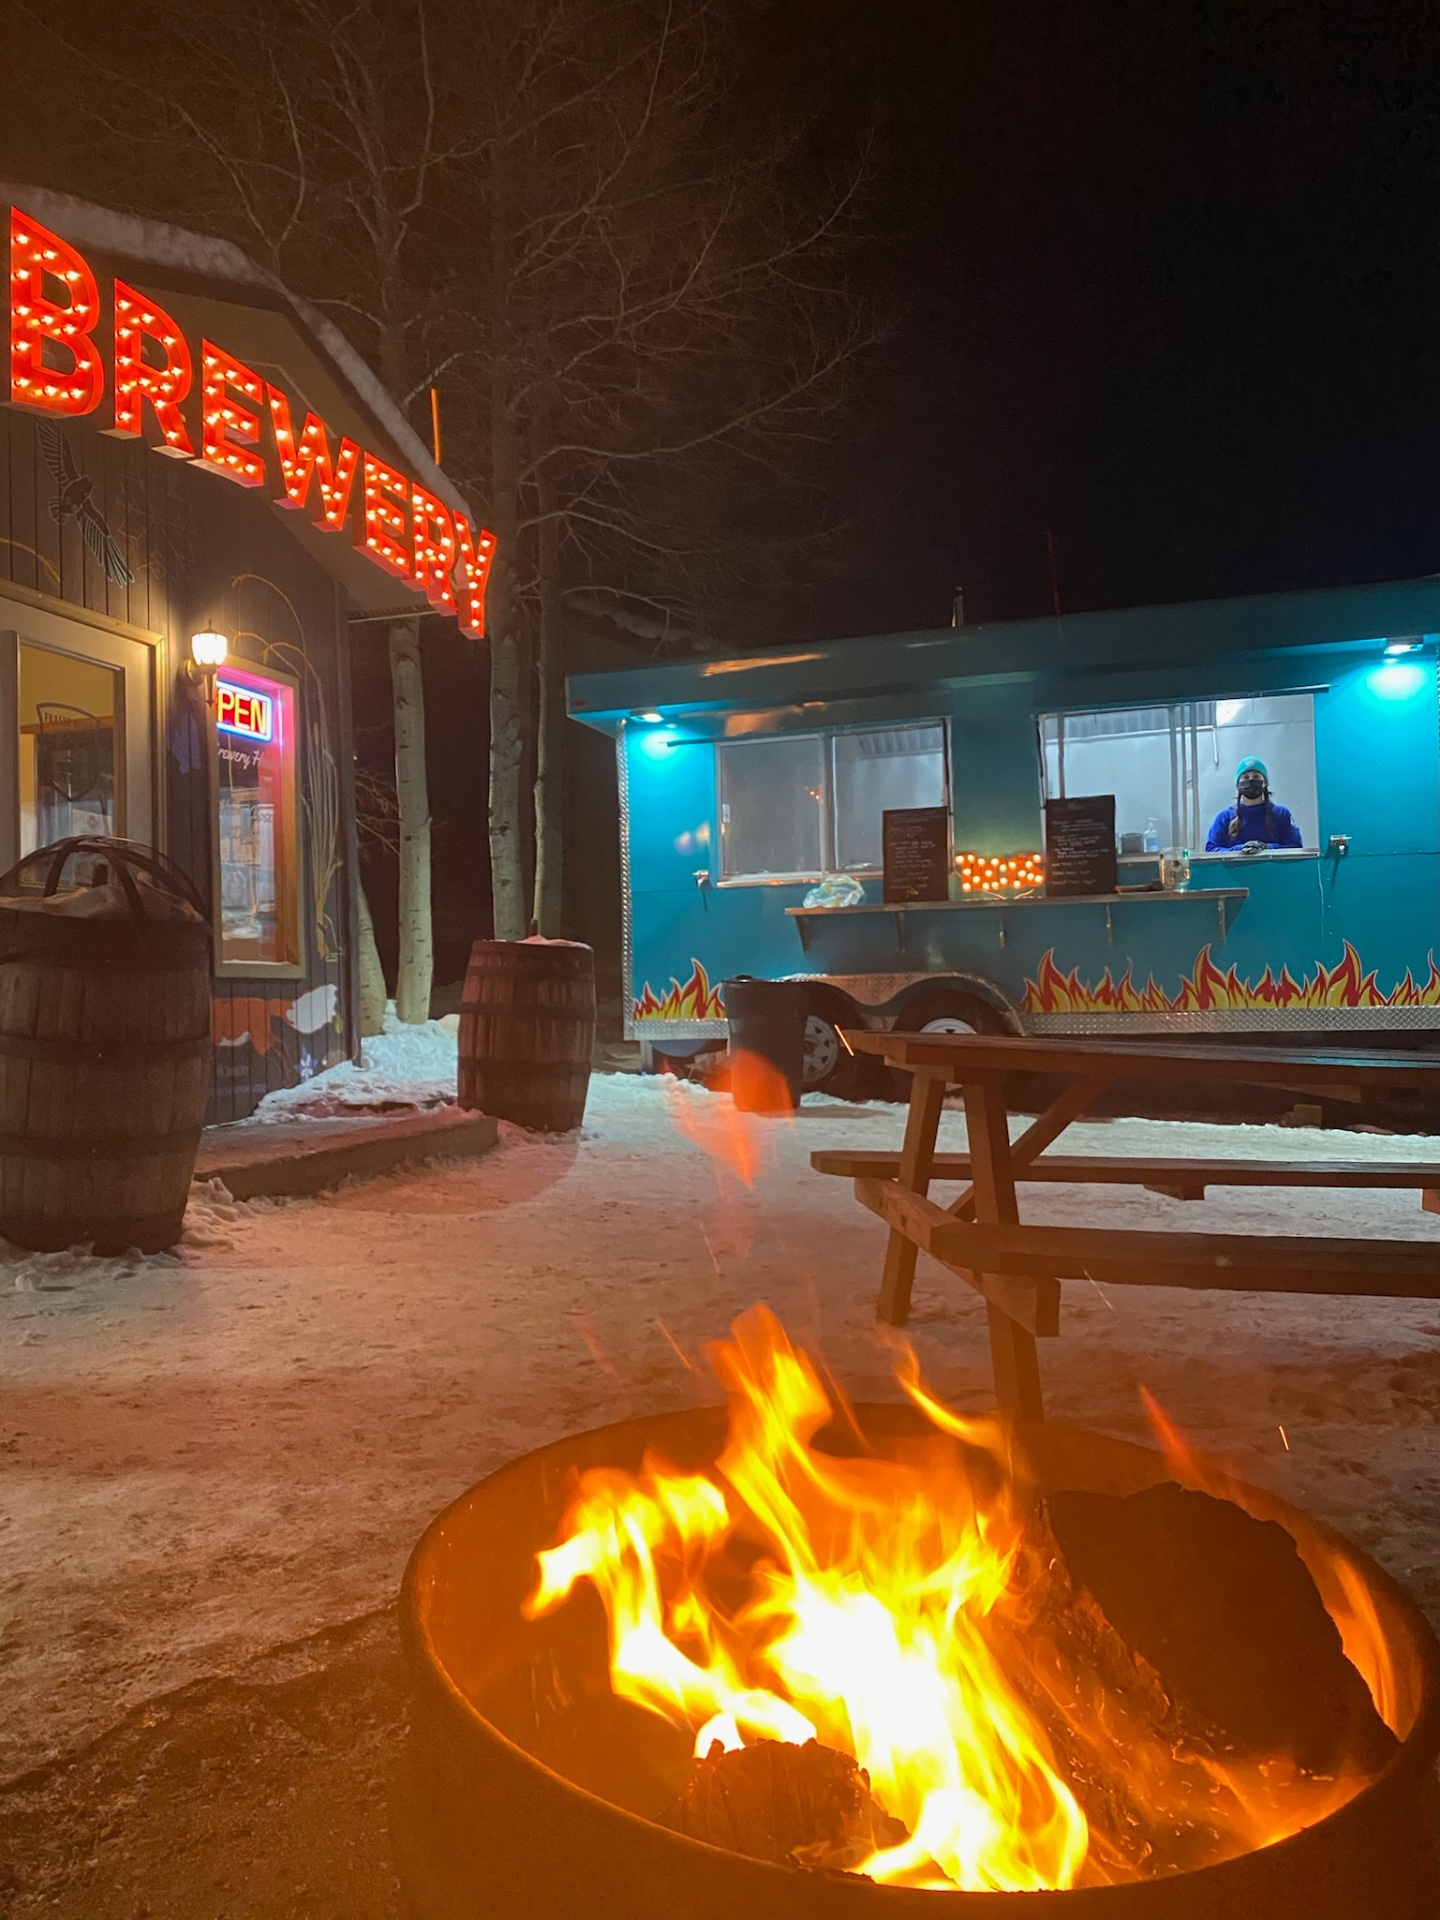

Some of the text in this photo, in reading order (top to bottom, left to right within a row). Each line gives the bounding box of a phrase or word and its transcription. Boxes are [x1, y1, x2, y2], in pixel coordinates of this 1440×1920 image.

[11, 206, 497, 640] BREWERY
[217, 688, 267, 735] PEN
[217, 744, 250, 770] rewery
